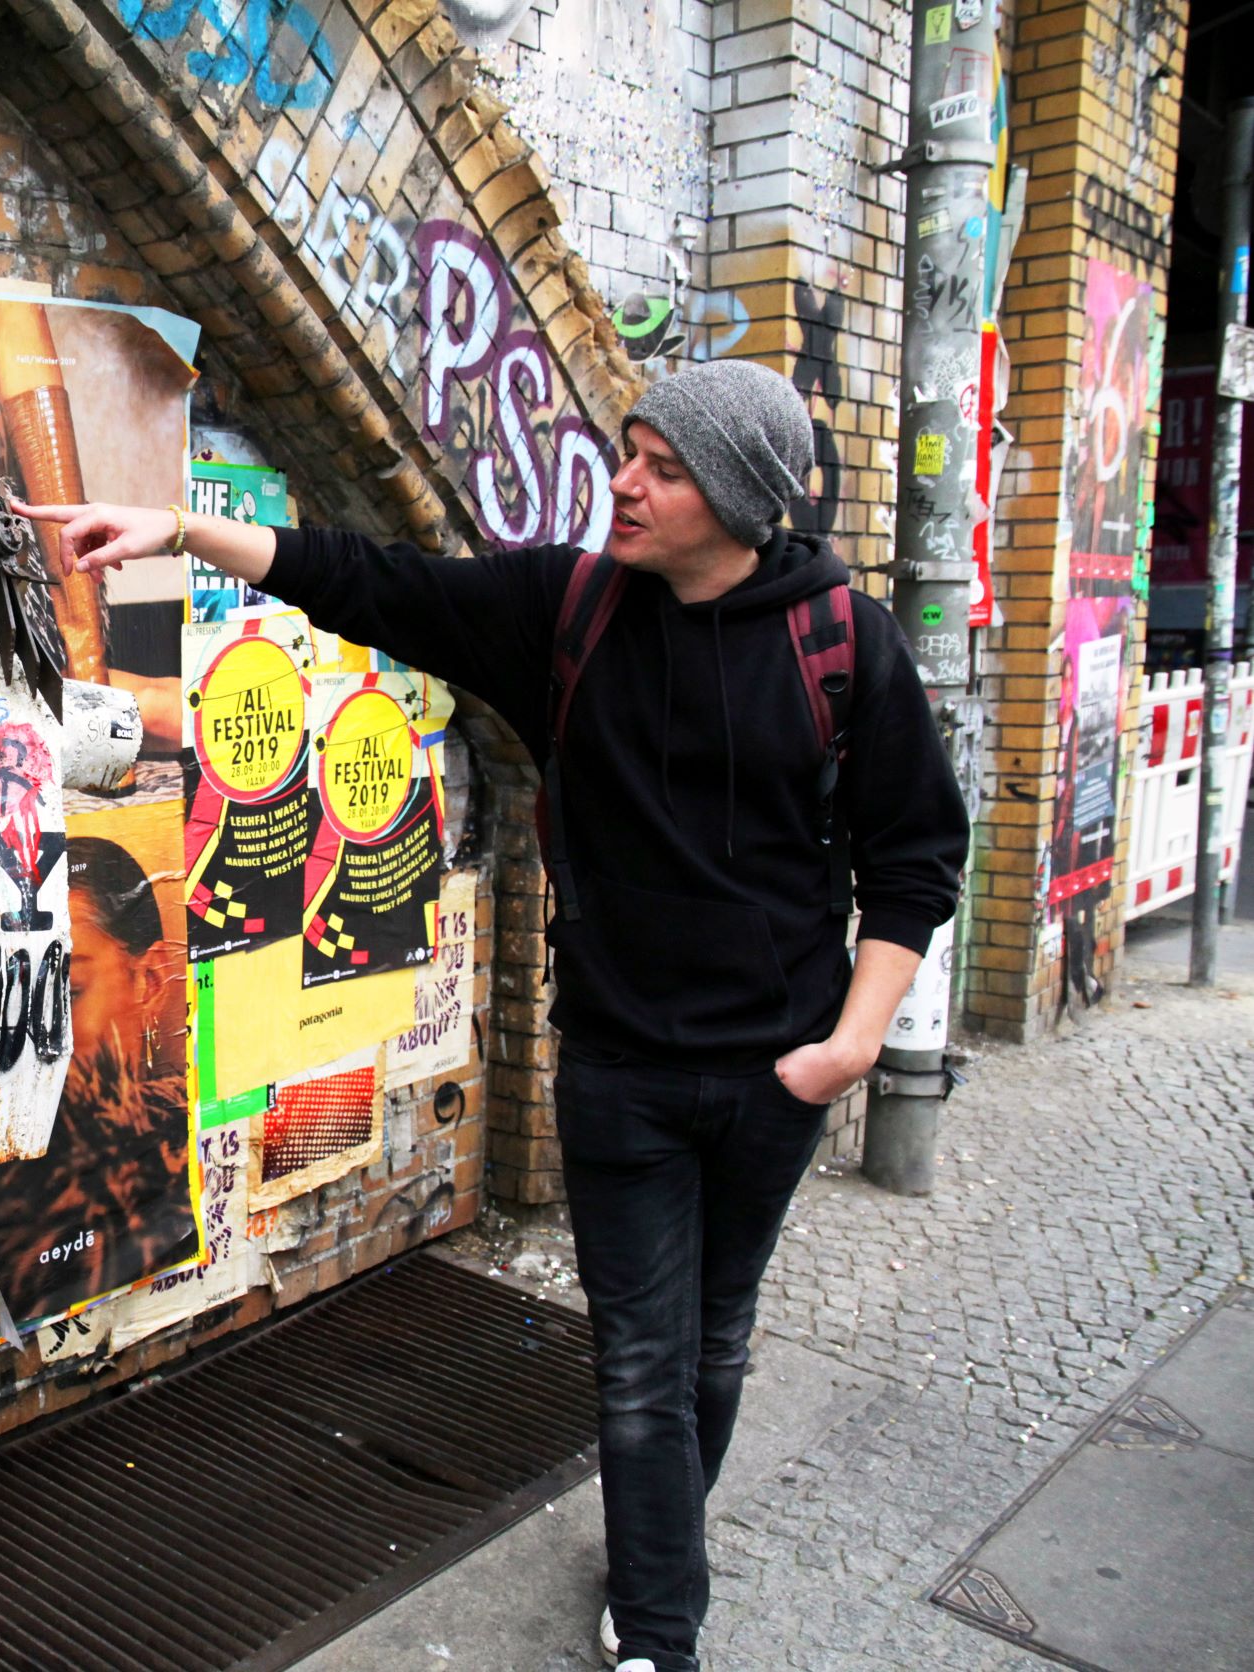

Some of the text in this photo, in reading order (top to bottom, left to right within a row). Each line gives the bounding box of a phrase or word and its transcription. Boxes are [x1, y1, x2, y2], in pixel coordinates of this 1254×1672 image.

[923, 611, 942, 620] KW
[214, 709, 295, 742] FESTIVAL
[231, 736, 278, 765] 2019
[231, 760, 281, 778] 28.09 20:00
[335, 758, 404, 785] FESTIVAL
[348, 782, 389, 808] 2019
[230, 814, 267, 827] LEKHFA
[274, 799, 299, 820] WAEL
[233, 828, 268, 840] MARYAM
[237, 842, 267, 854] TAMER
[268, 835, 287, 850] ABU
[224, 856, 262, 867] MAURICE
[262, 849, 288, 865] LOUCA
[345, 854, 378, 866] LEKHFA
[382, 842, 404, 861] WAEL
[71, 863, 87, 873] 2019
[264, 861, 292, 878] TWIST
[348, 868, 379, 878] MARYAM
[351, 880, 378, 890] TAMER
[339, 891, 371, 903] MAURICE
[371, 888, 393, 902] LOUCA
[372, 889, 413, 915] TWIST FIRE
[299, 1005, 343, 1030] patagonia
